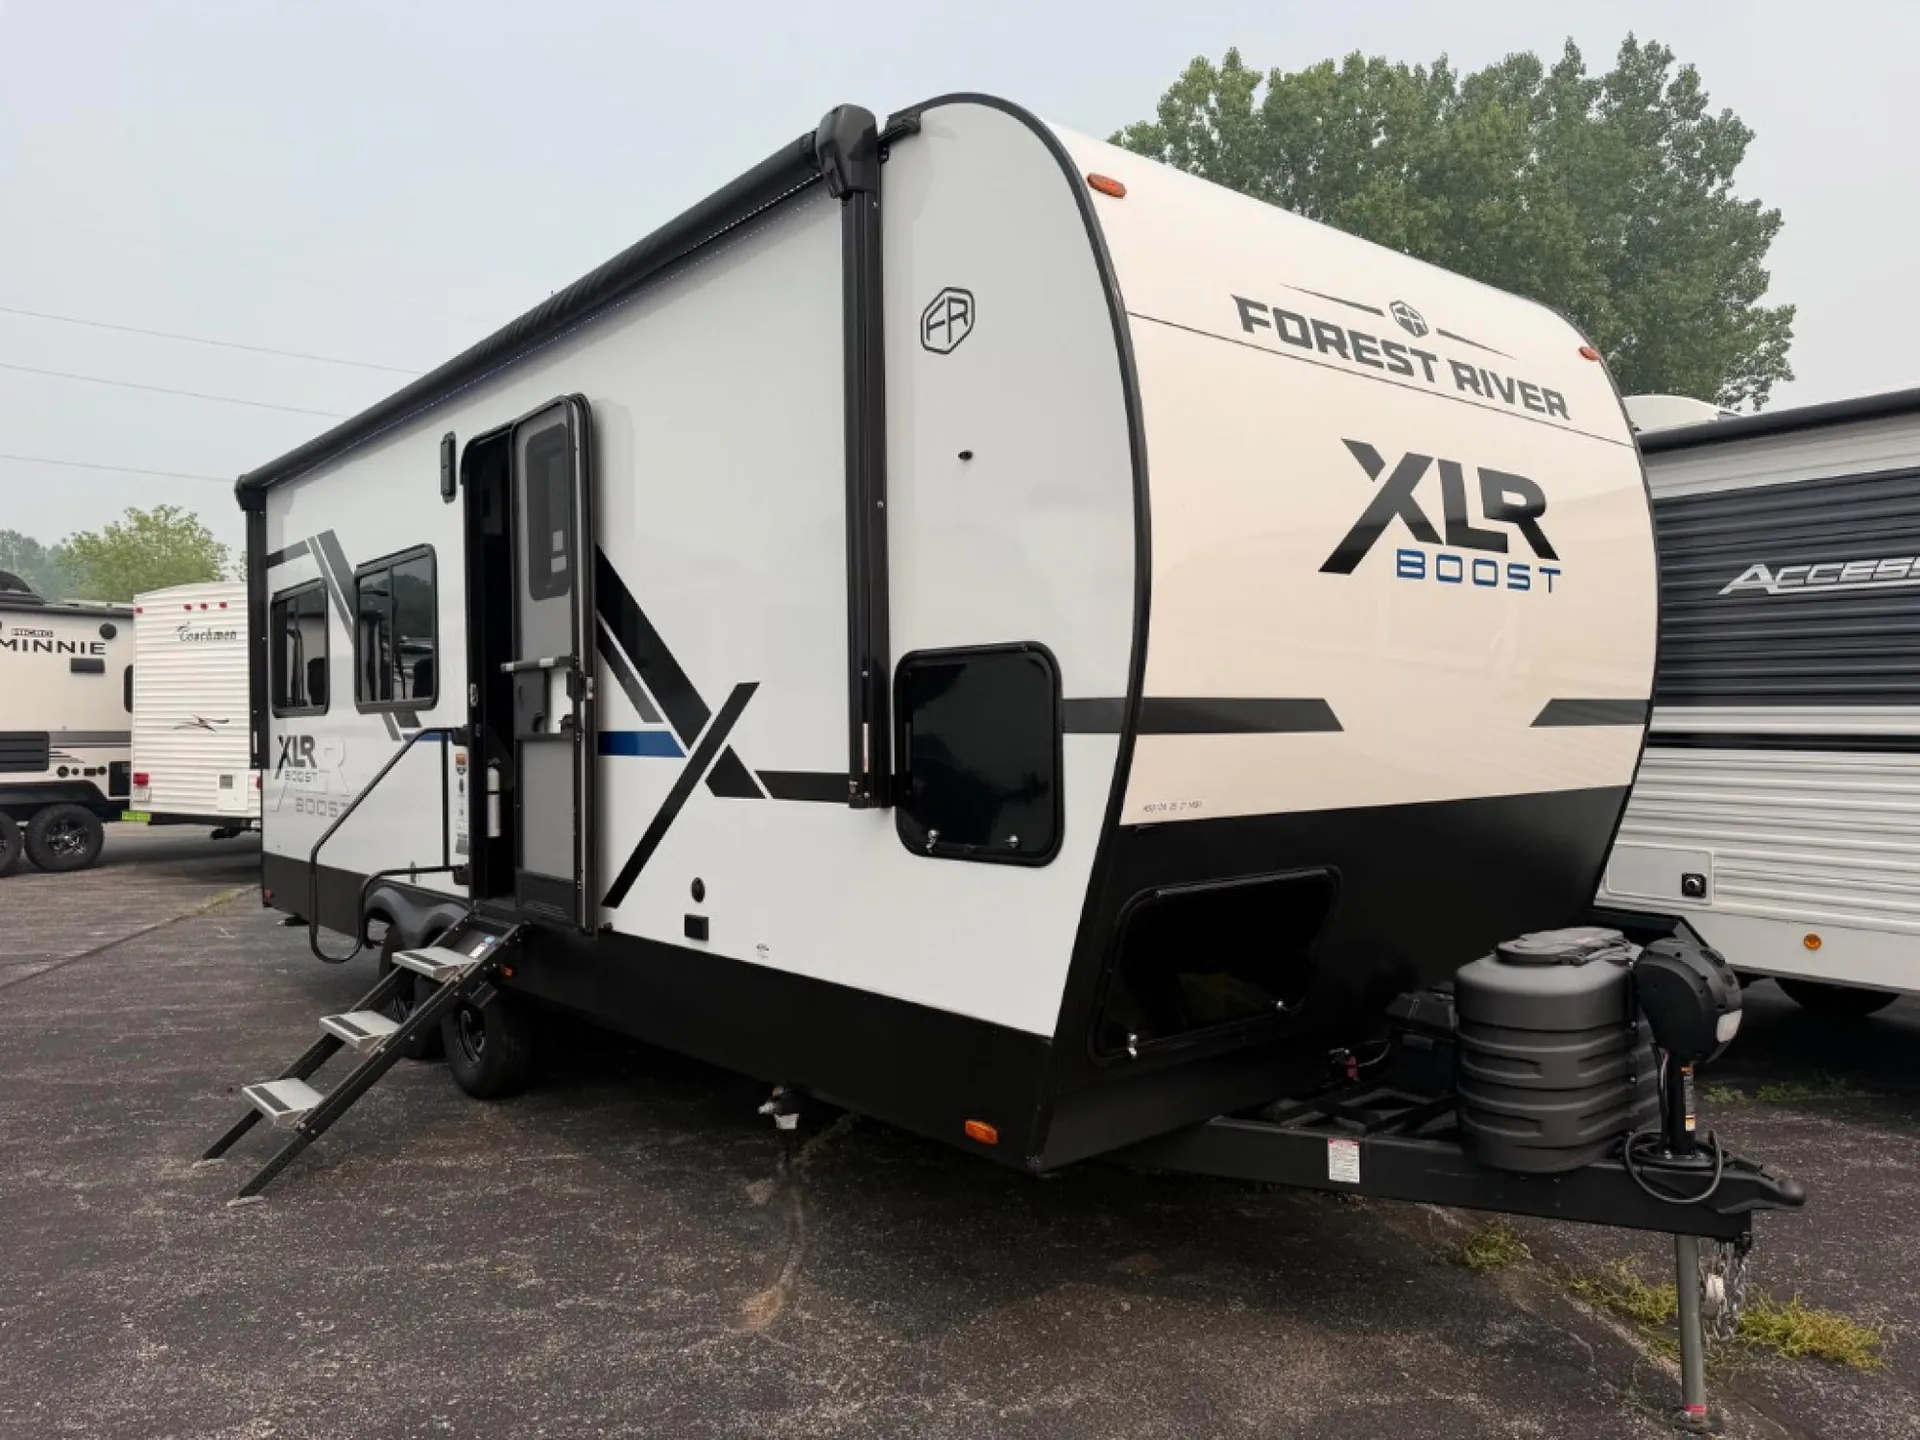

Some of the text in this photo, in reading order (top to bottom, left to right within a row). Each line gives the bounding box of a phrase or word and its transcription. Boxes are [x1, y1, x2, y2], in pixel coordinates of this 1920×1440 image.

[1230, 294, 1571, 421] FOREST RIVER
[1317, 437, 1560, 575] XLR
[1396, 548, 1561, 594] BOOST
[1717, 556, 1920, 595] ACCES
[0, 638, 106, 655] MINNIE
[274, 735, 318, 780] XLR
